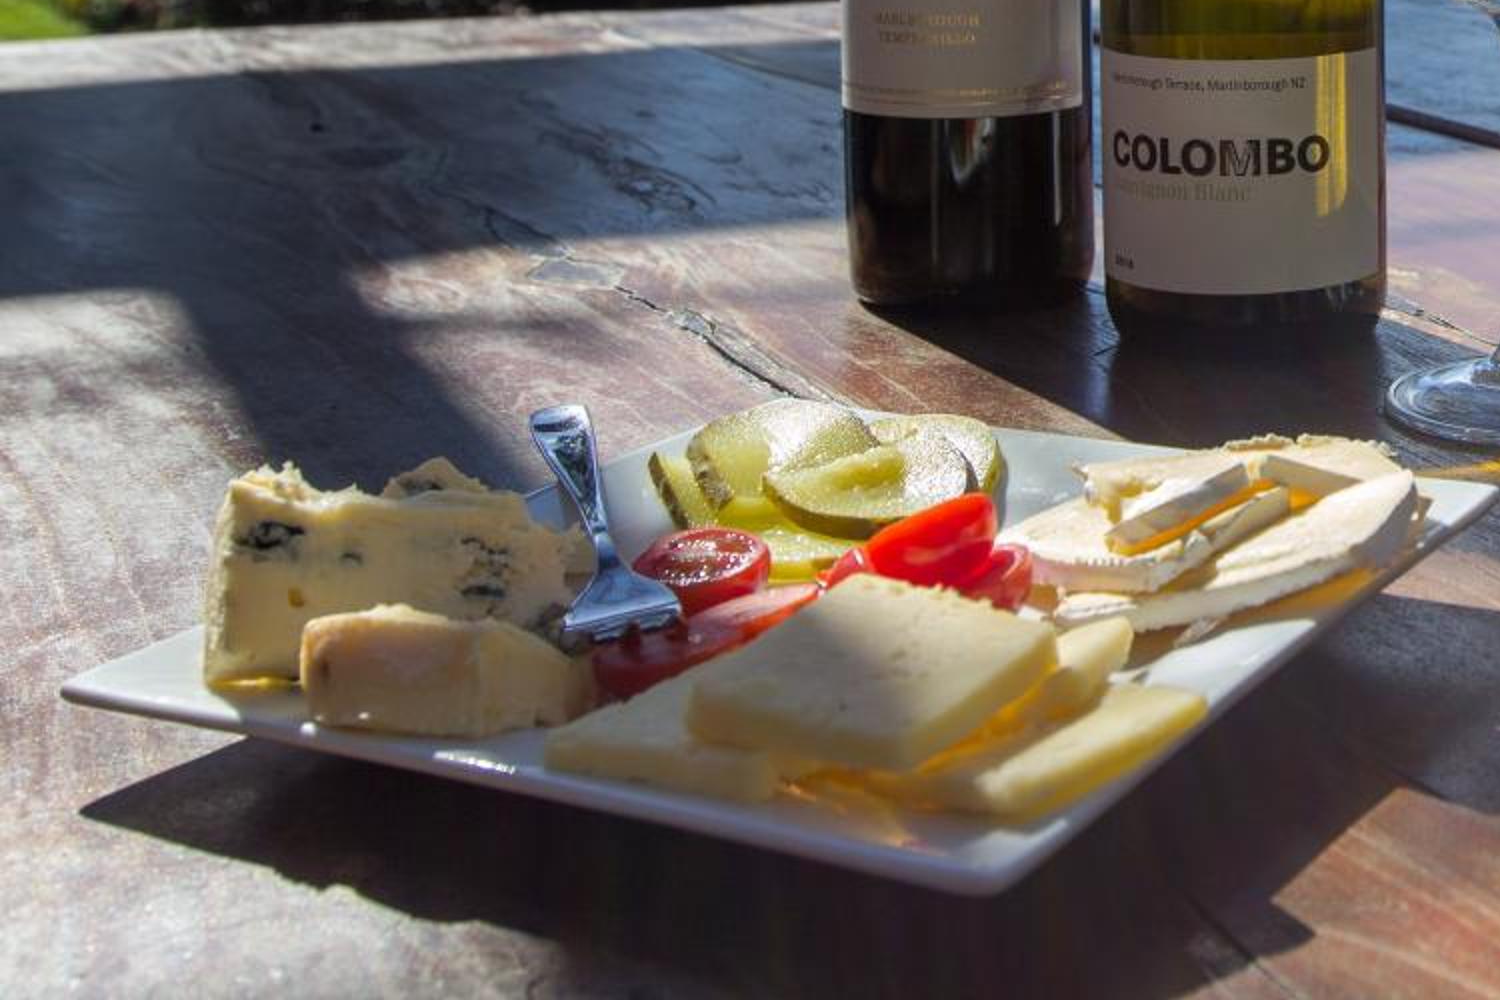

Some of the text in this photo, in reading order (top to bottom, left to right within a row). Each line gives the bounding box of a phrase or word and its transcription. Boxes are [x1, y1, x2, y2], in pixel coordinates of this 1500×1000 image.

[1165, 78, 1204, 93] Terrace,
[1291, 77, 1307, 89] NZ
[1113, 130, 1330, 177] COLOMBO
